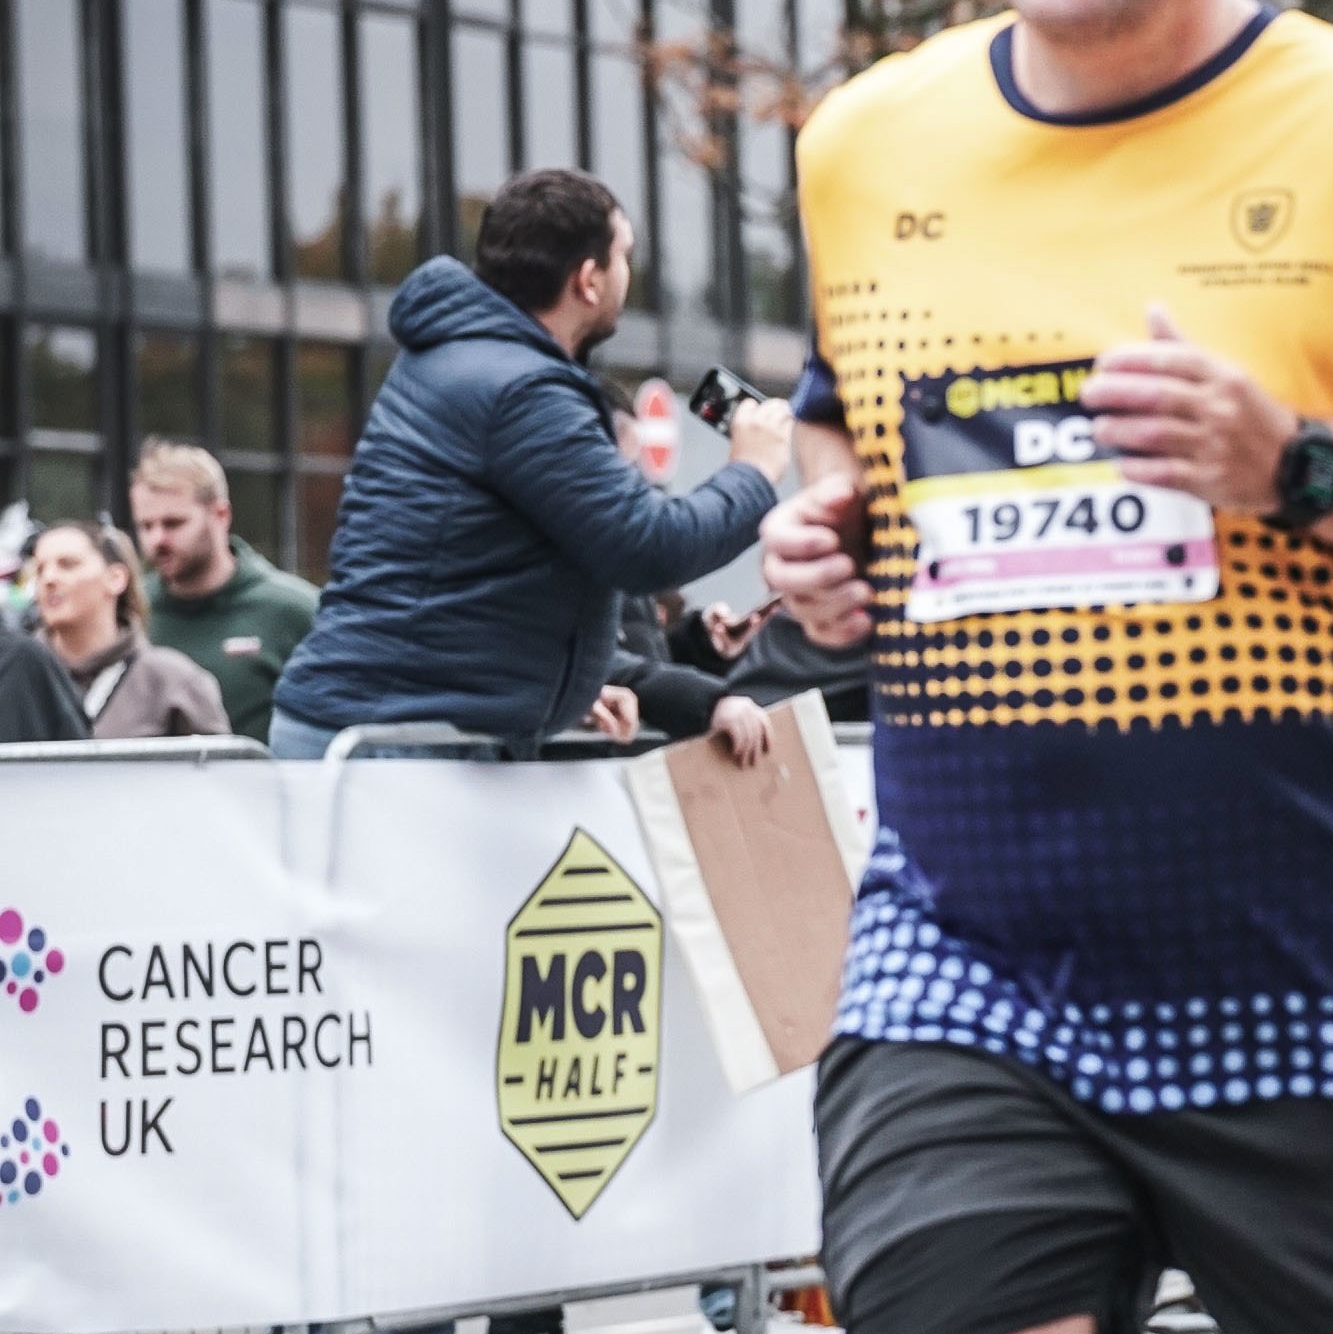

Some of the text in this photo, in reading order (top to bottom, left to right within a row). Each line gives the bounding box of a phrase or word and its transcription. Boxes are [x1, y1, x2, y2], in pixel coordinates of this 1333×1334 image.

[895, 213, 944, 241] DC
[1013, 416, 1095, 466] DC
[964, 493, 1145, 543] 19740
[99, 939, 323, 1001] CANCER
[516, 950, 646, 1043] MCR
[101, 1010, 373, 1078] RESEARCH
[535, 1053, 627, 1100] HALF
[100, 1098, 174, 1156] UK
